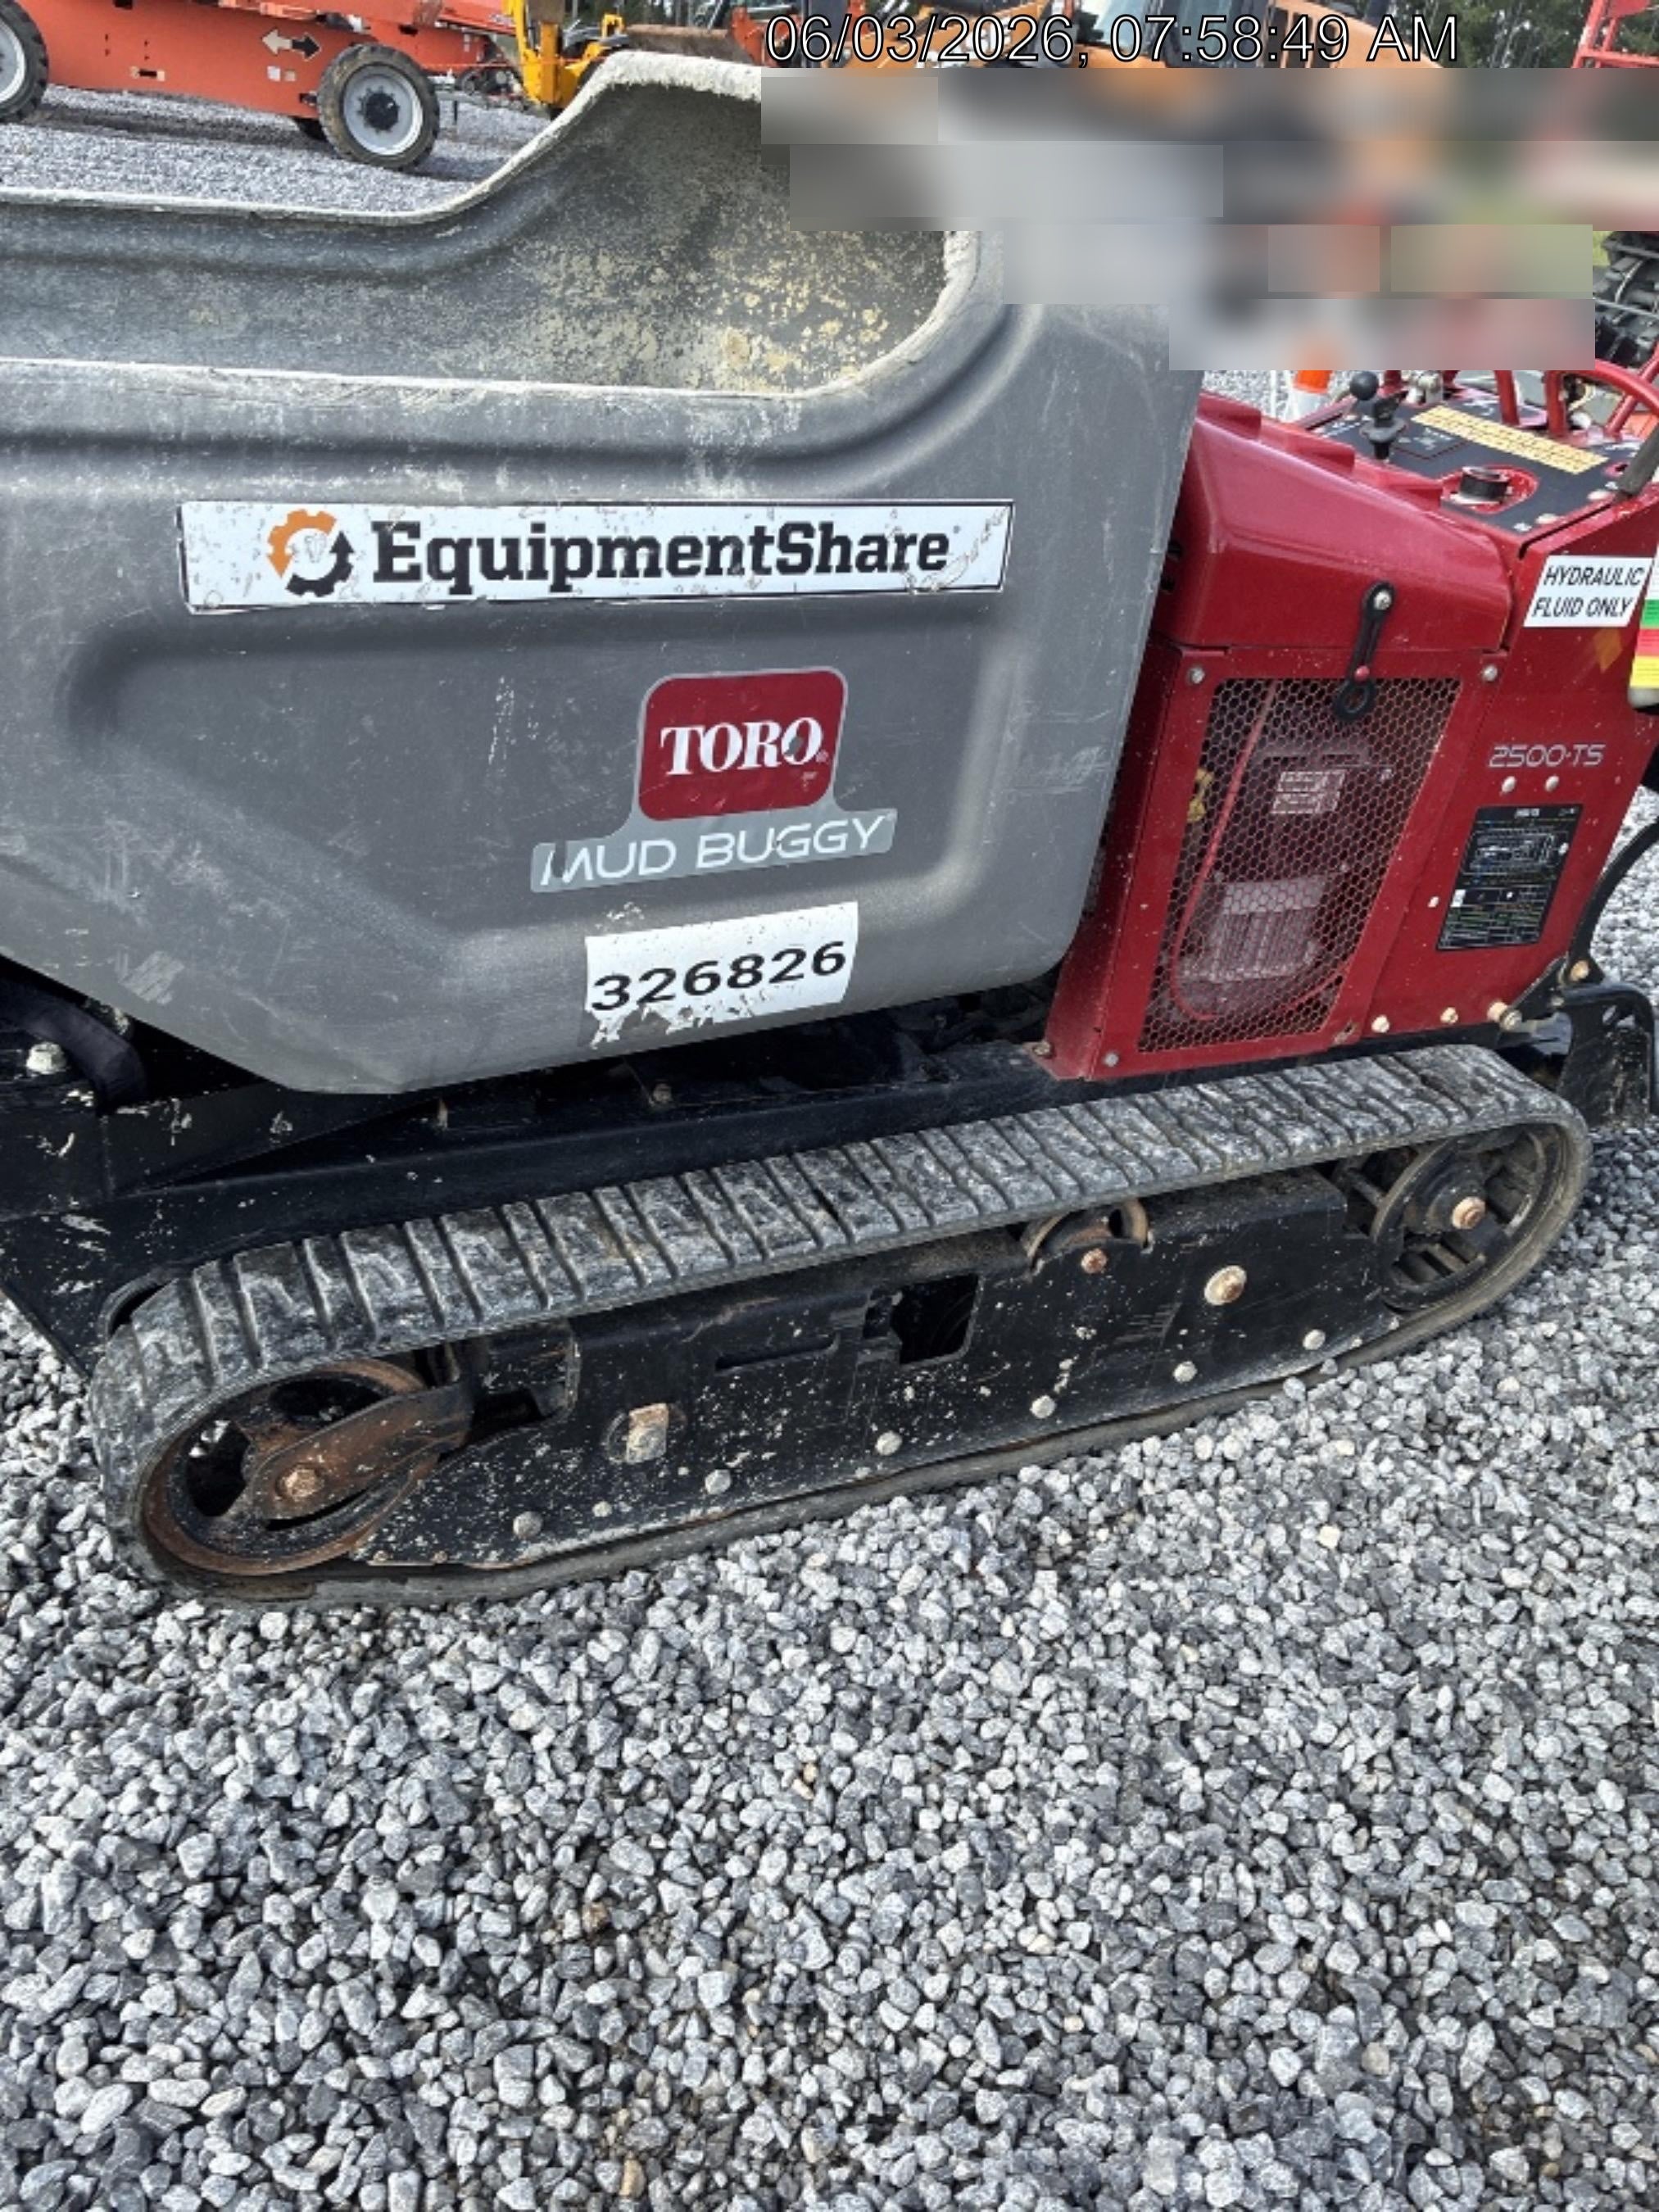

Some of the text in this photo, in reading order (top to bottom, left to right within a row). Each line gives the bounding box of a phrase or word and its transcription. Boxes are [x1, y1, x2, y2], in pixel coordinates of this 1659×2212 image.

[373, 520, 950, 596] EquipmentShare
[1543, 566, 1644, 587] HYDRAULIC
[1532, 596, 1583, 619] FLUID
[1585, 596, 1634, 619] ONLY
[660, 717, 823, 777] TORO
[540, 815, 886, 886] MUD BUGGY
[591, 941, 846, 1011] 326826
